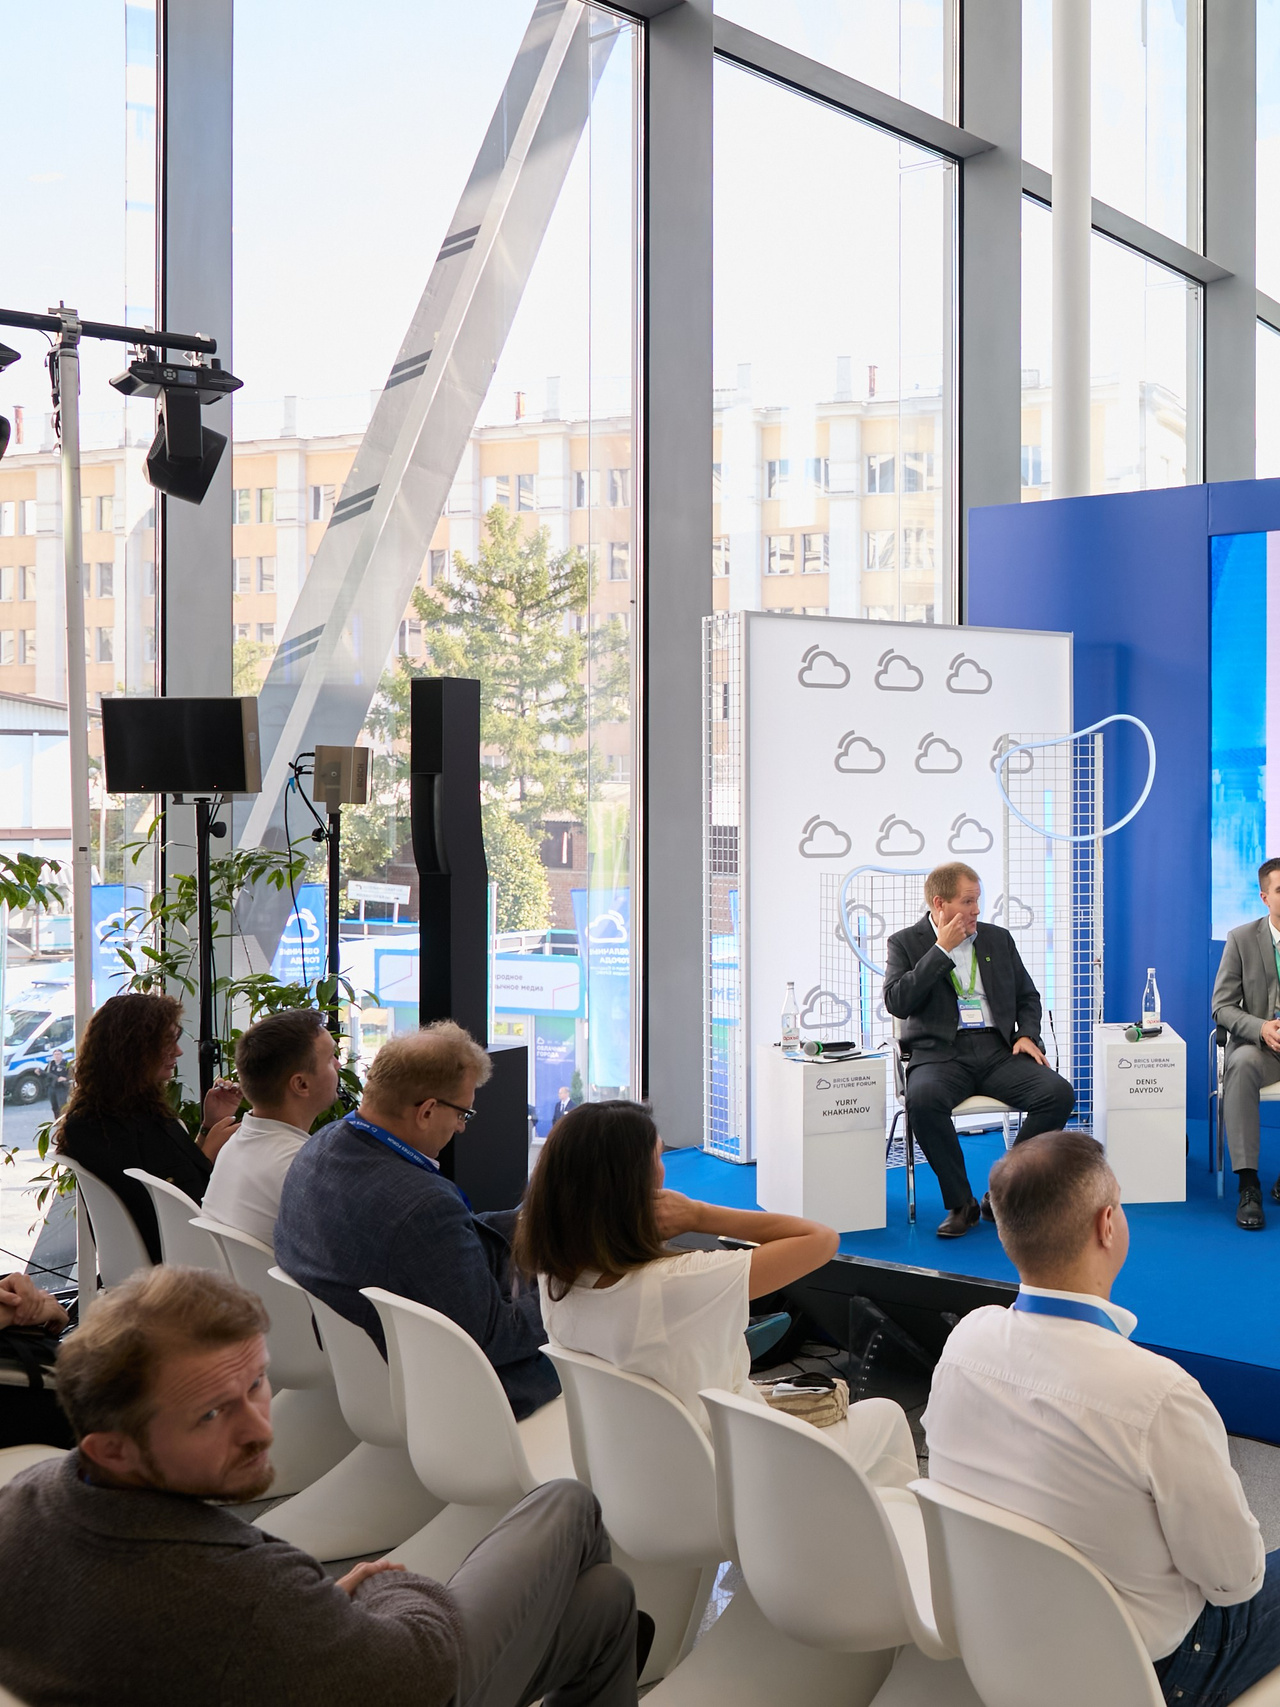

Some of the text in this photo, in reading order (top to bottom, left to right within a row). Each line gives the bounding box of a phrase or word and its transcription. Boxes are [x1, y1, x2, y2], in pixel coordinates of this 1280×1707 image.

[356, 763, 364, 788] BOSCH
[1136, 1078, 1157, 1086] DENIS
[1129, 1086, 1164, 1094] DAVYDOV
[835, 1098, 858, 1106] YURIY
[822, 1106, 871, 1117] KHAKHANOV
[387, 1136, 402, 1149] FORUM
